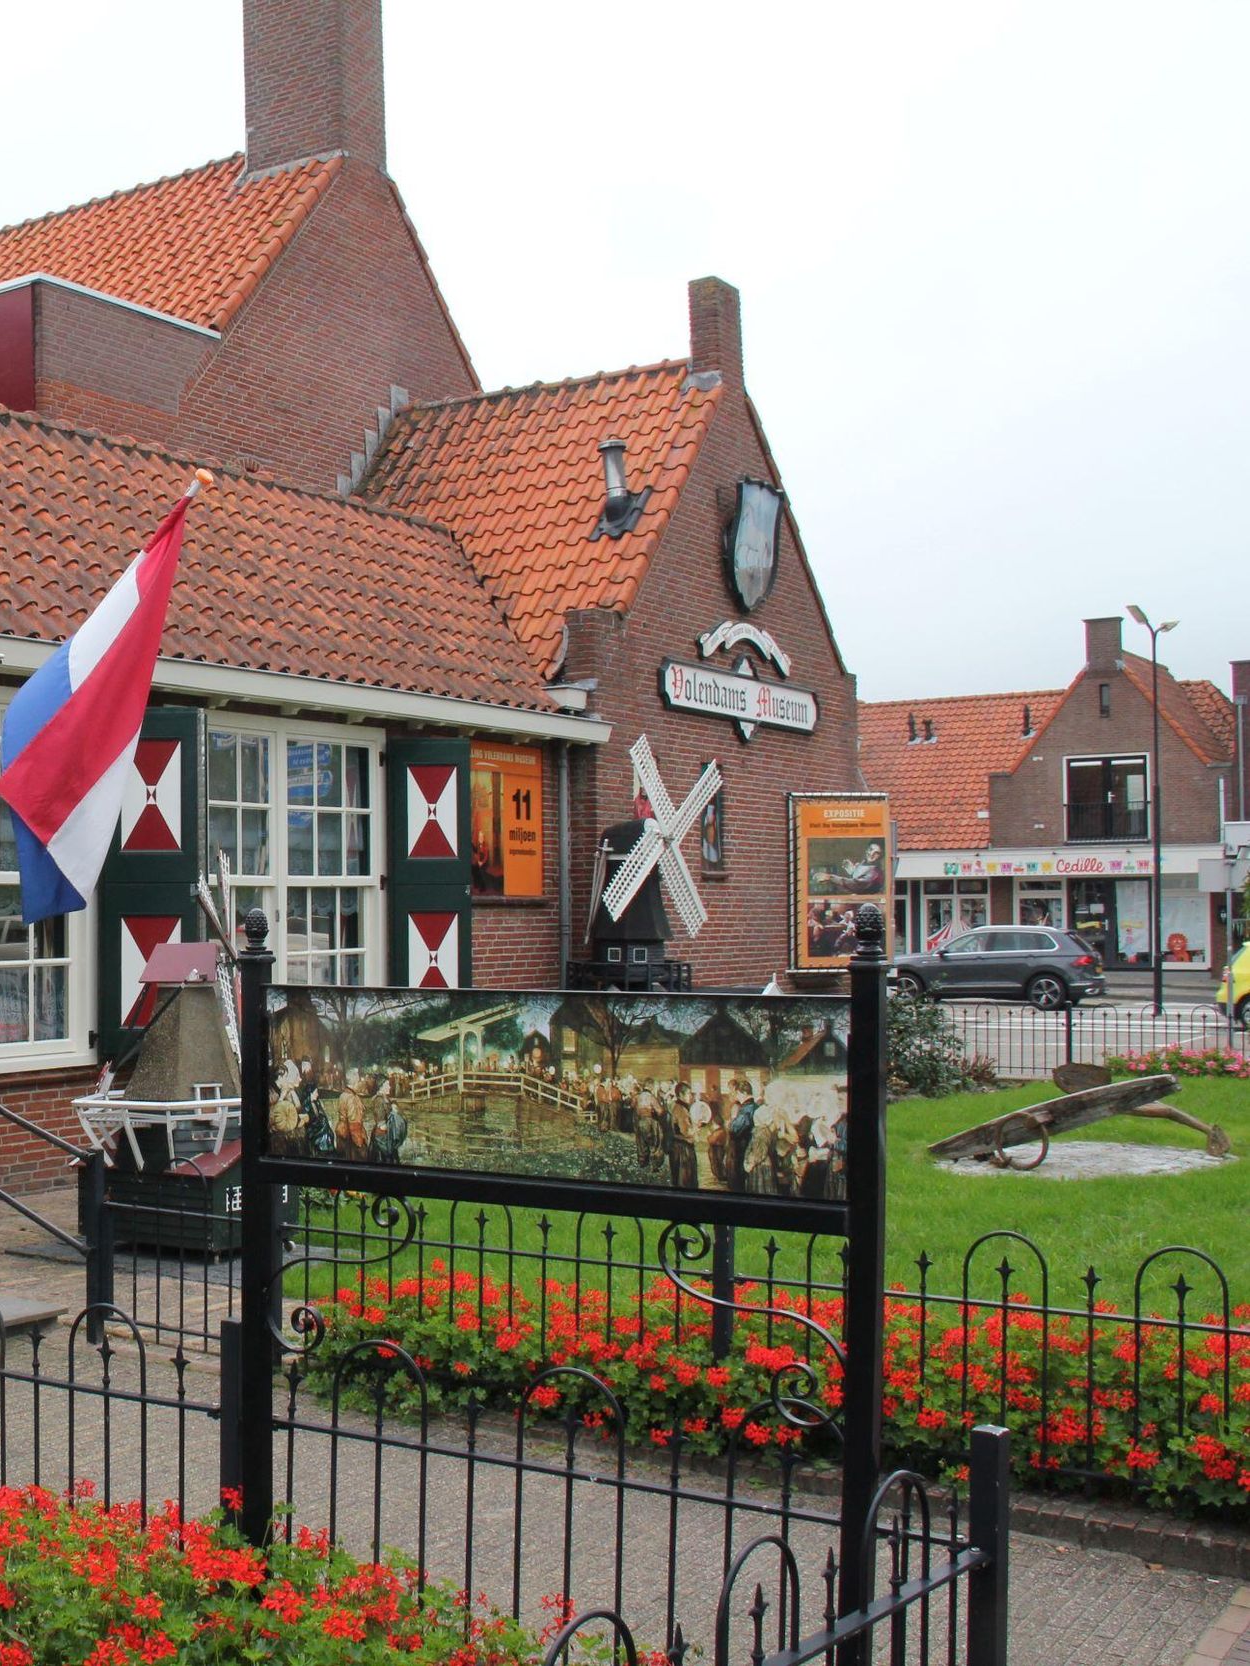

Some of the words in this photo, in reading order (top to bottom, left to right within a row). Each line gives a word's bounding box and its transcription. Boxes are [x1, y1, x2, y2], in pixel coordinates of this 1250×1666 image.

[671, 665, 747, 712] Volendams
[756, 686, 808, 723] Museum
[512, 788, 531, 820] 11
[823, 809, 865, 818] EXPOSITIE
[509, 828, 536, 844] miljoen
